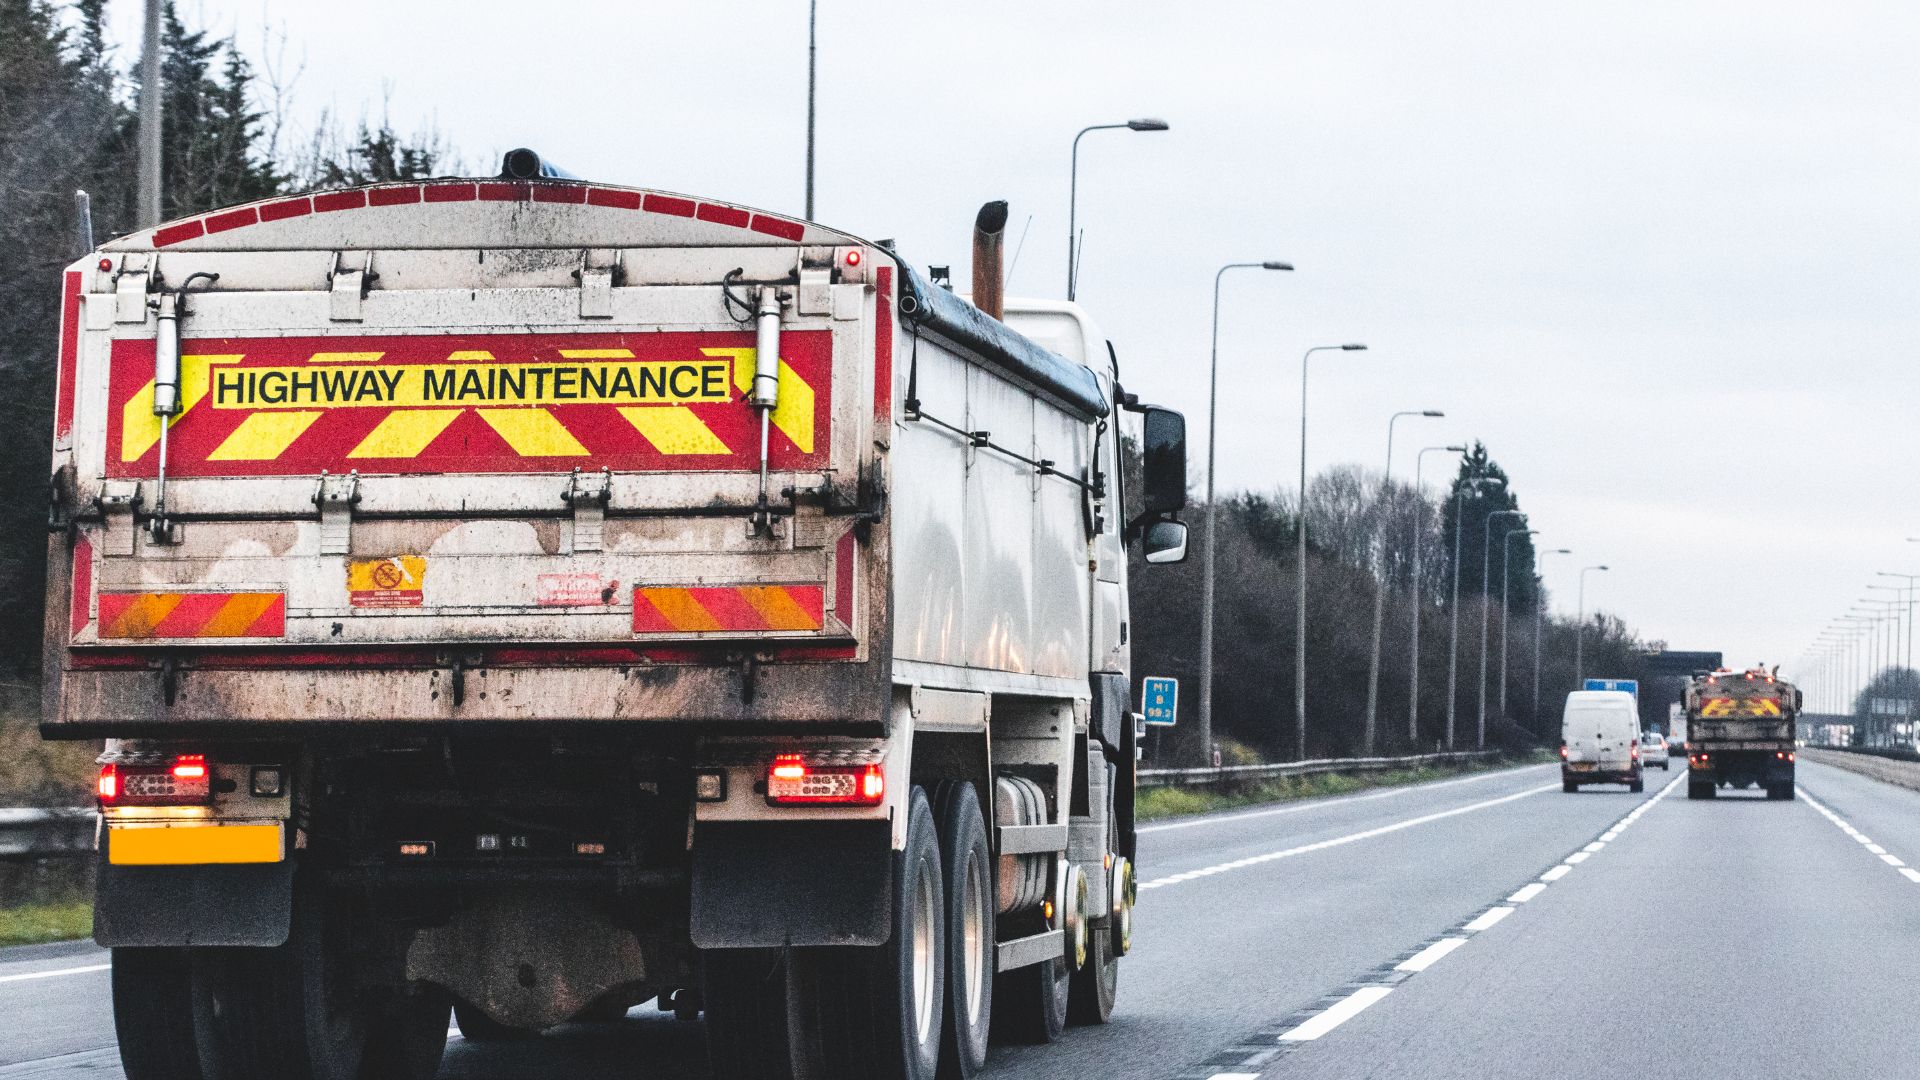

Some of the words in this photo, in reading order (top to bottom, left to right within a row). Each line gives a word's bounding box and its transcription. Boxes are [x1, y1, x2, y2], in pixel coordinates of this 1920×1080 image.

[217, 369, 405, 404] HIGHWAY
[423, 365, 726, 401] MAINTENANCE
[1153, 683, 1169, 692] M1
